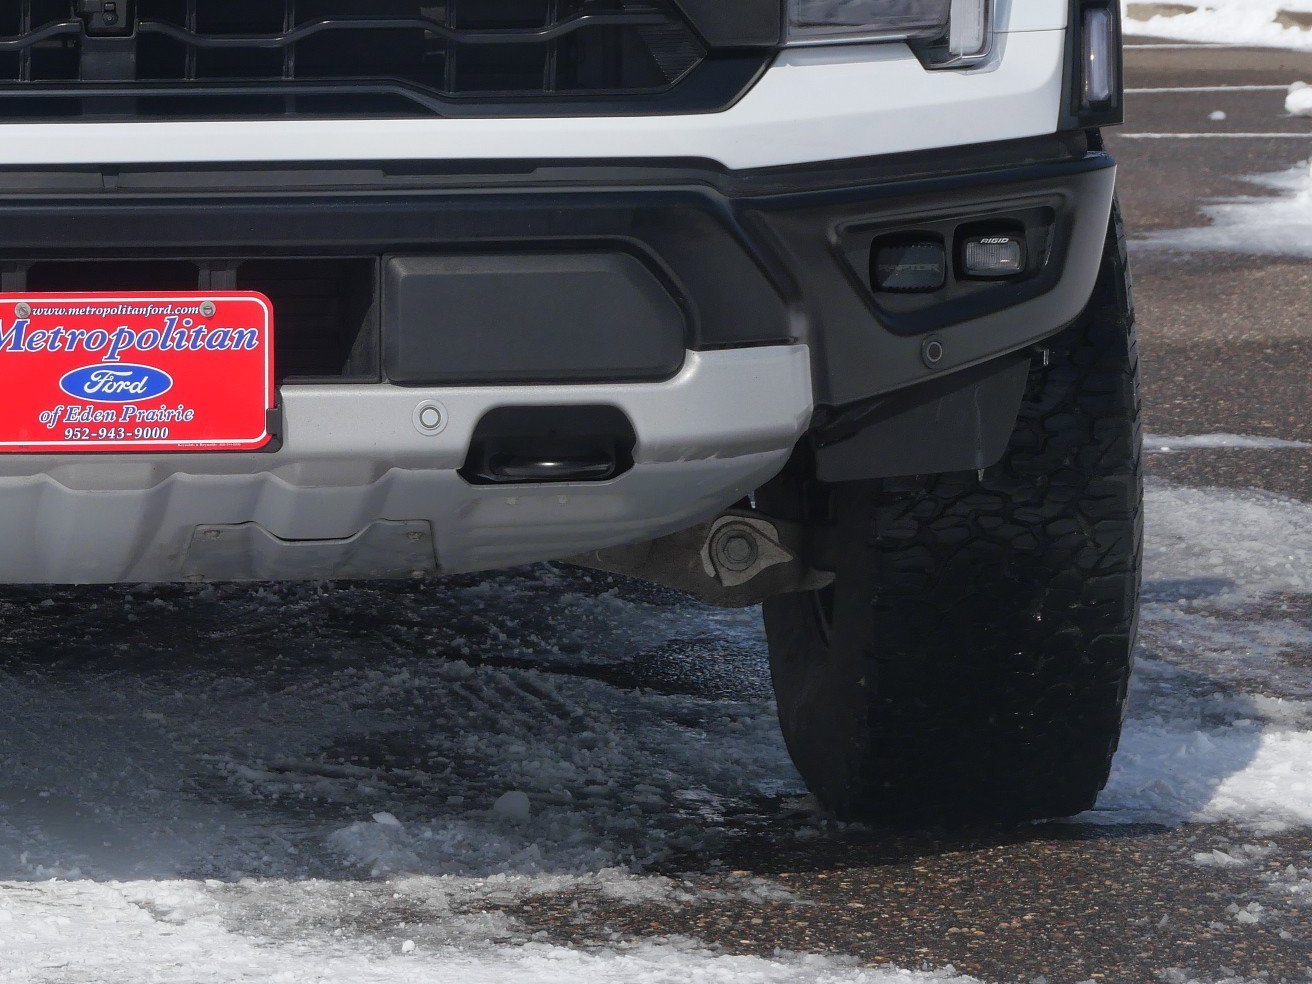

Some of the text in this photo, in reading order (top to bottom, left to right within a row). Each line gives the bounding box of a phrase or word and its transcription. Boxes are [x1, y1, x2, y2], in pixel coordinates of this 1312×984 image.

[31, 303, 200, 318] www.metropolitanford.com
[83, 369, 148, 395] Ford
[38, 404, 194, 429] of Eden Prairie
[64, 426, 169, 441] 952-943-9000
